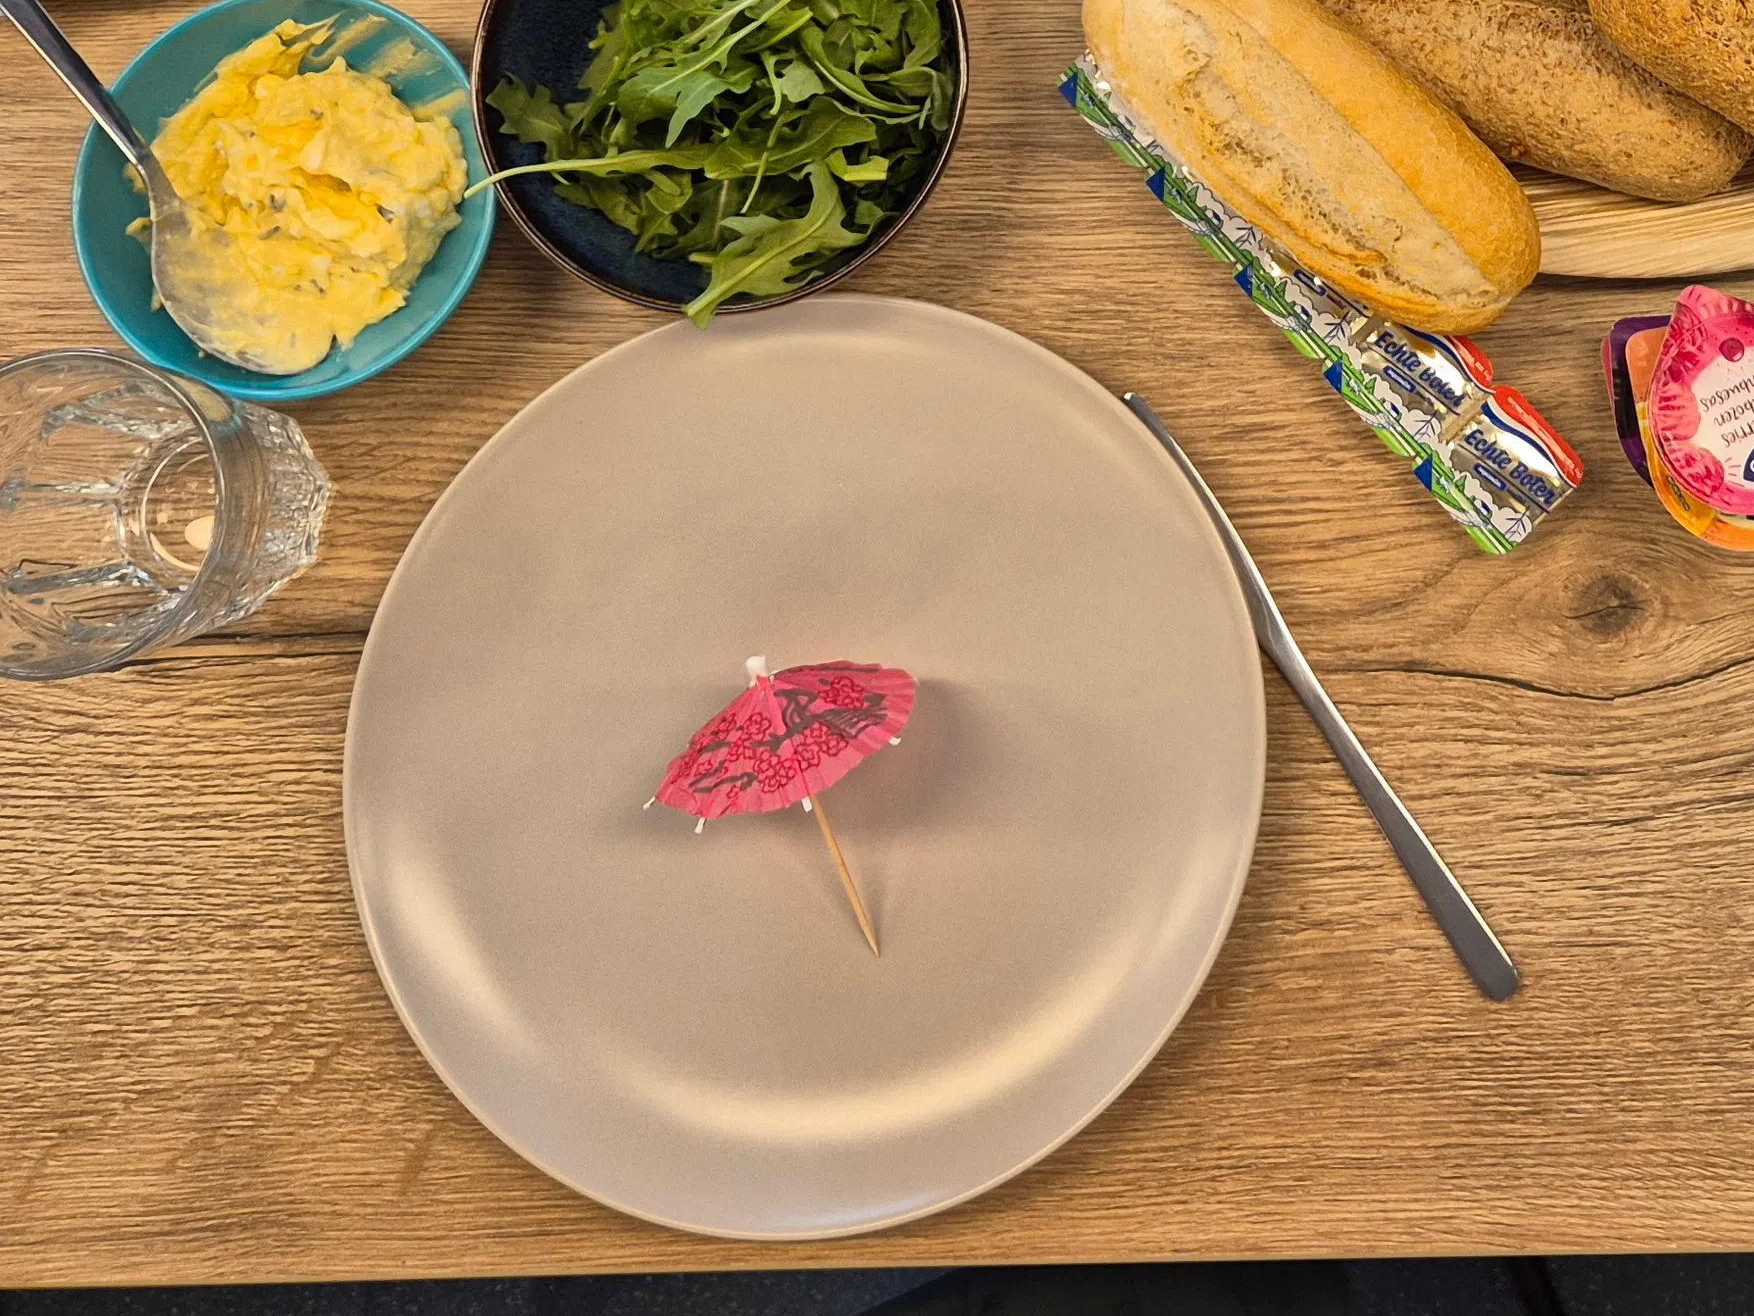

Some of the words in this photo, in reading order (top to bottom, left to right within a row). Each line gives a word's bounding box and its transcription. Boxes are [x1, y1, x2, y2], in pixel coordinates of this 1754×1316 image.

[1374, 330, 1421, 372] Echte
[1419, 366, 1467, 407] Boter
[1463, 428, 1512, 470] Echte
[1509, 462, 1556, 505] Boter
